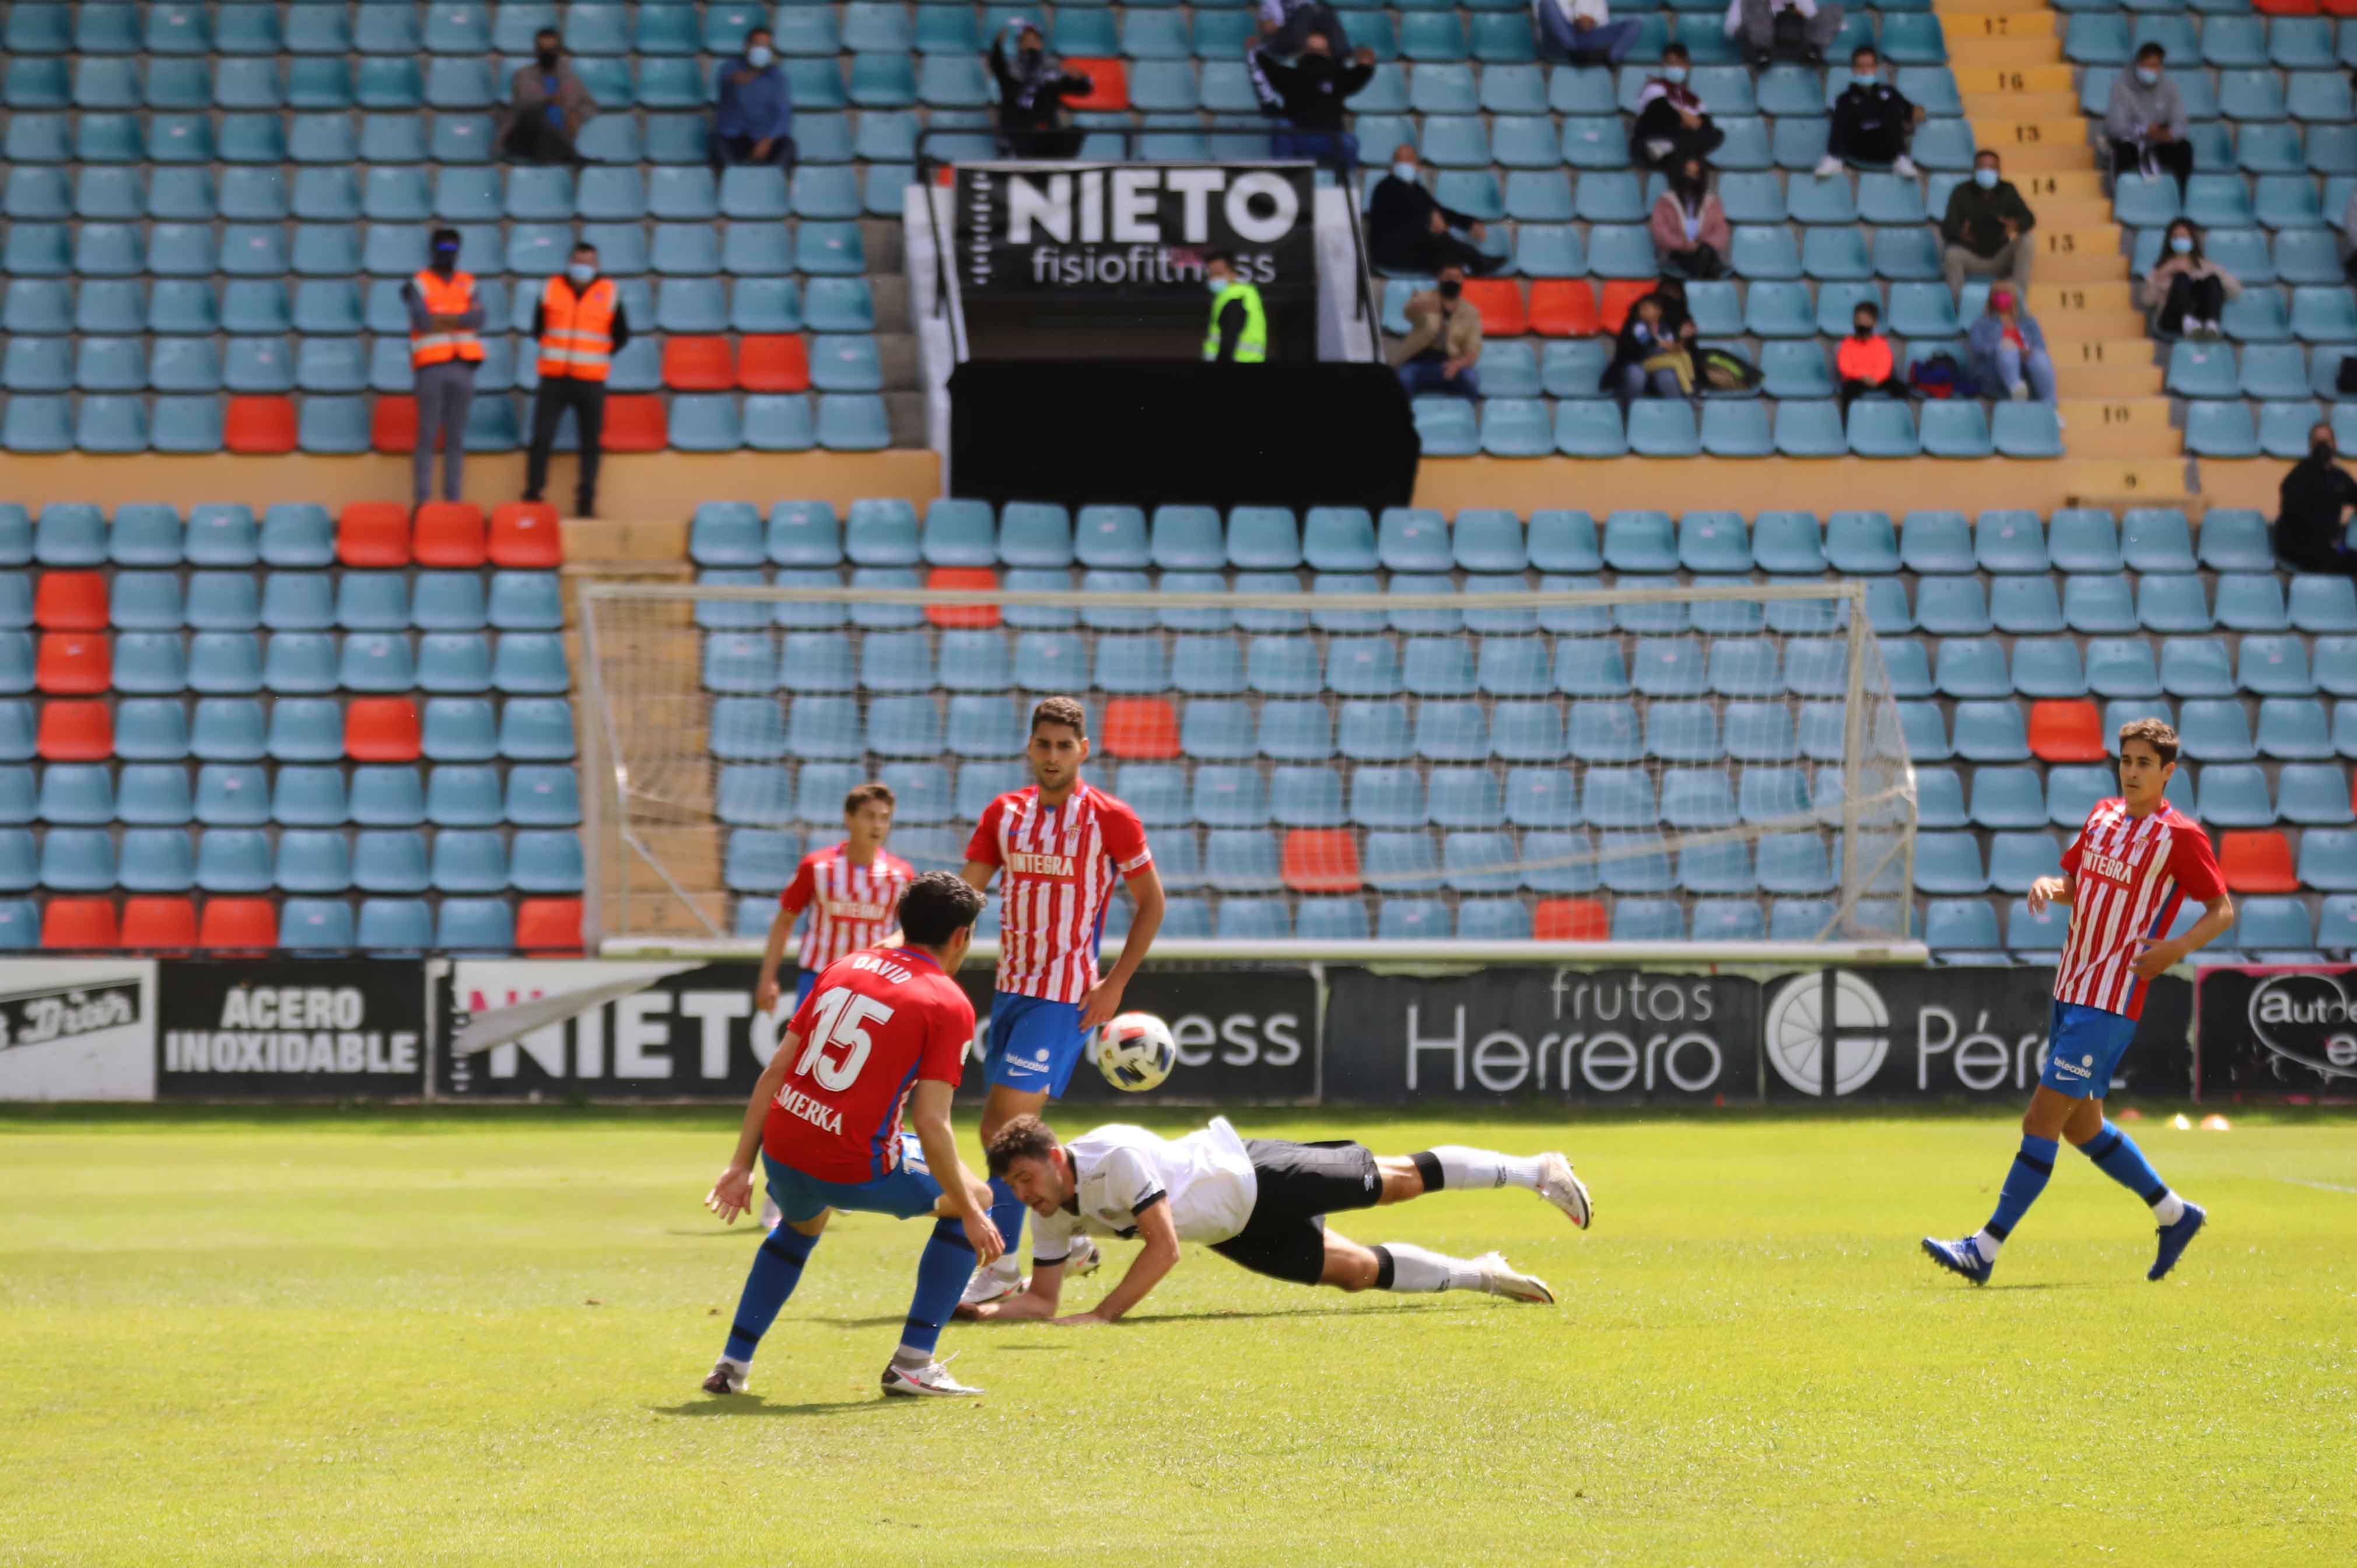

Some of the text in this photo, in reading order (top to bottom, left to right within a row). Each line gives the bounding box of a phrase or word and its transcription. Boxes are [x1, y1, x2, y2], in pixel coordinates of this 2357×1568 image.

[1007, 170, 1299, 243] NIETO
[1032, 245, 1276, 285] fisiofitnss
[2083, 342, 2103, 362] 11
[1012, 853, 1074, 876] INTEGRA
[2082, 848, 2133, 885] INTEGRA
[851, 955, 913, 985] DAVID
[219, 986, 365, 1030] ACERO
[1550, 969, 1713, 1022] frutas
[165, 1030, 419, 1074] INOXIDABLE
[794, 985, 895, 1092] 15
[1406, 1002, 1722, 1092] Herrero
[1918, 1005, 2127, 1091] Pér
[2053, 1056, 2092, 1079] telecable
[774, 1082, 843, 1136] MERKA
